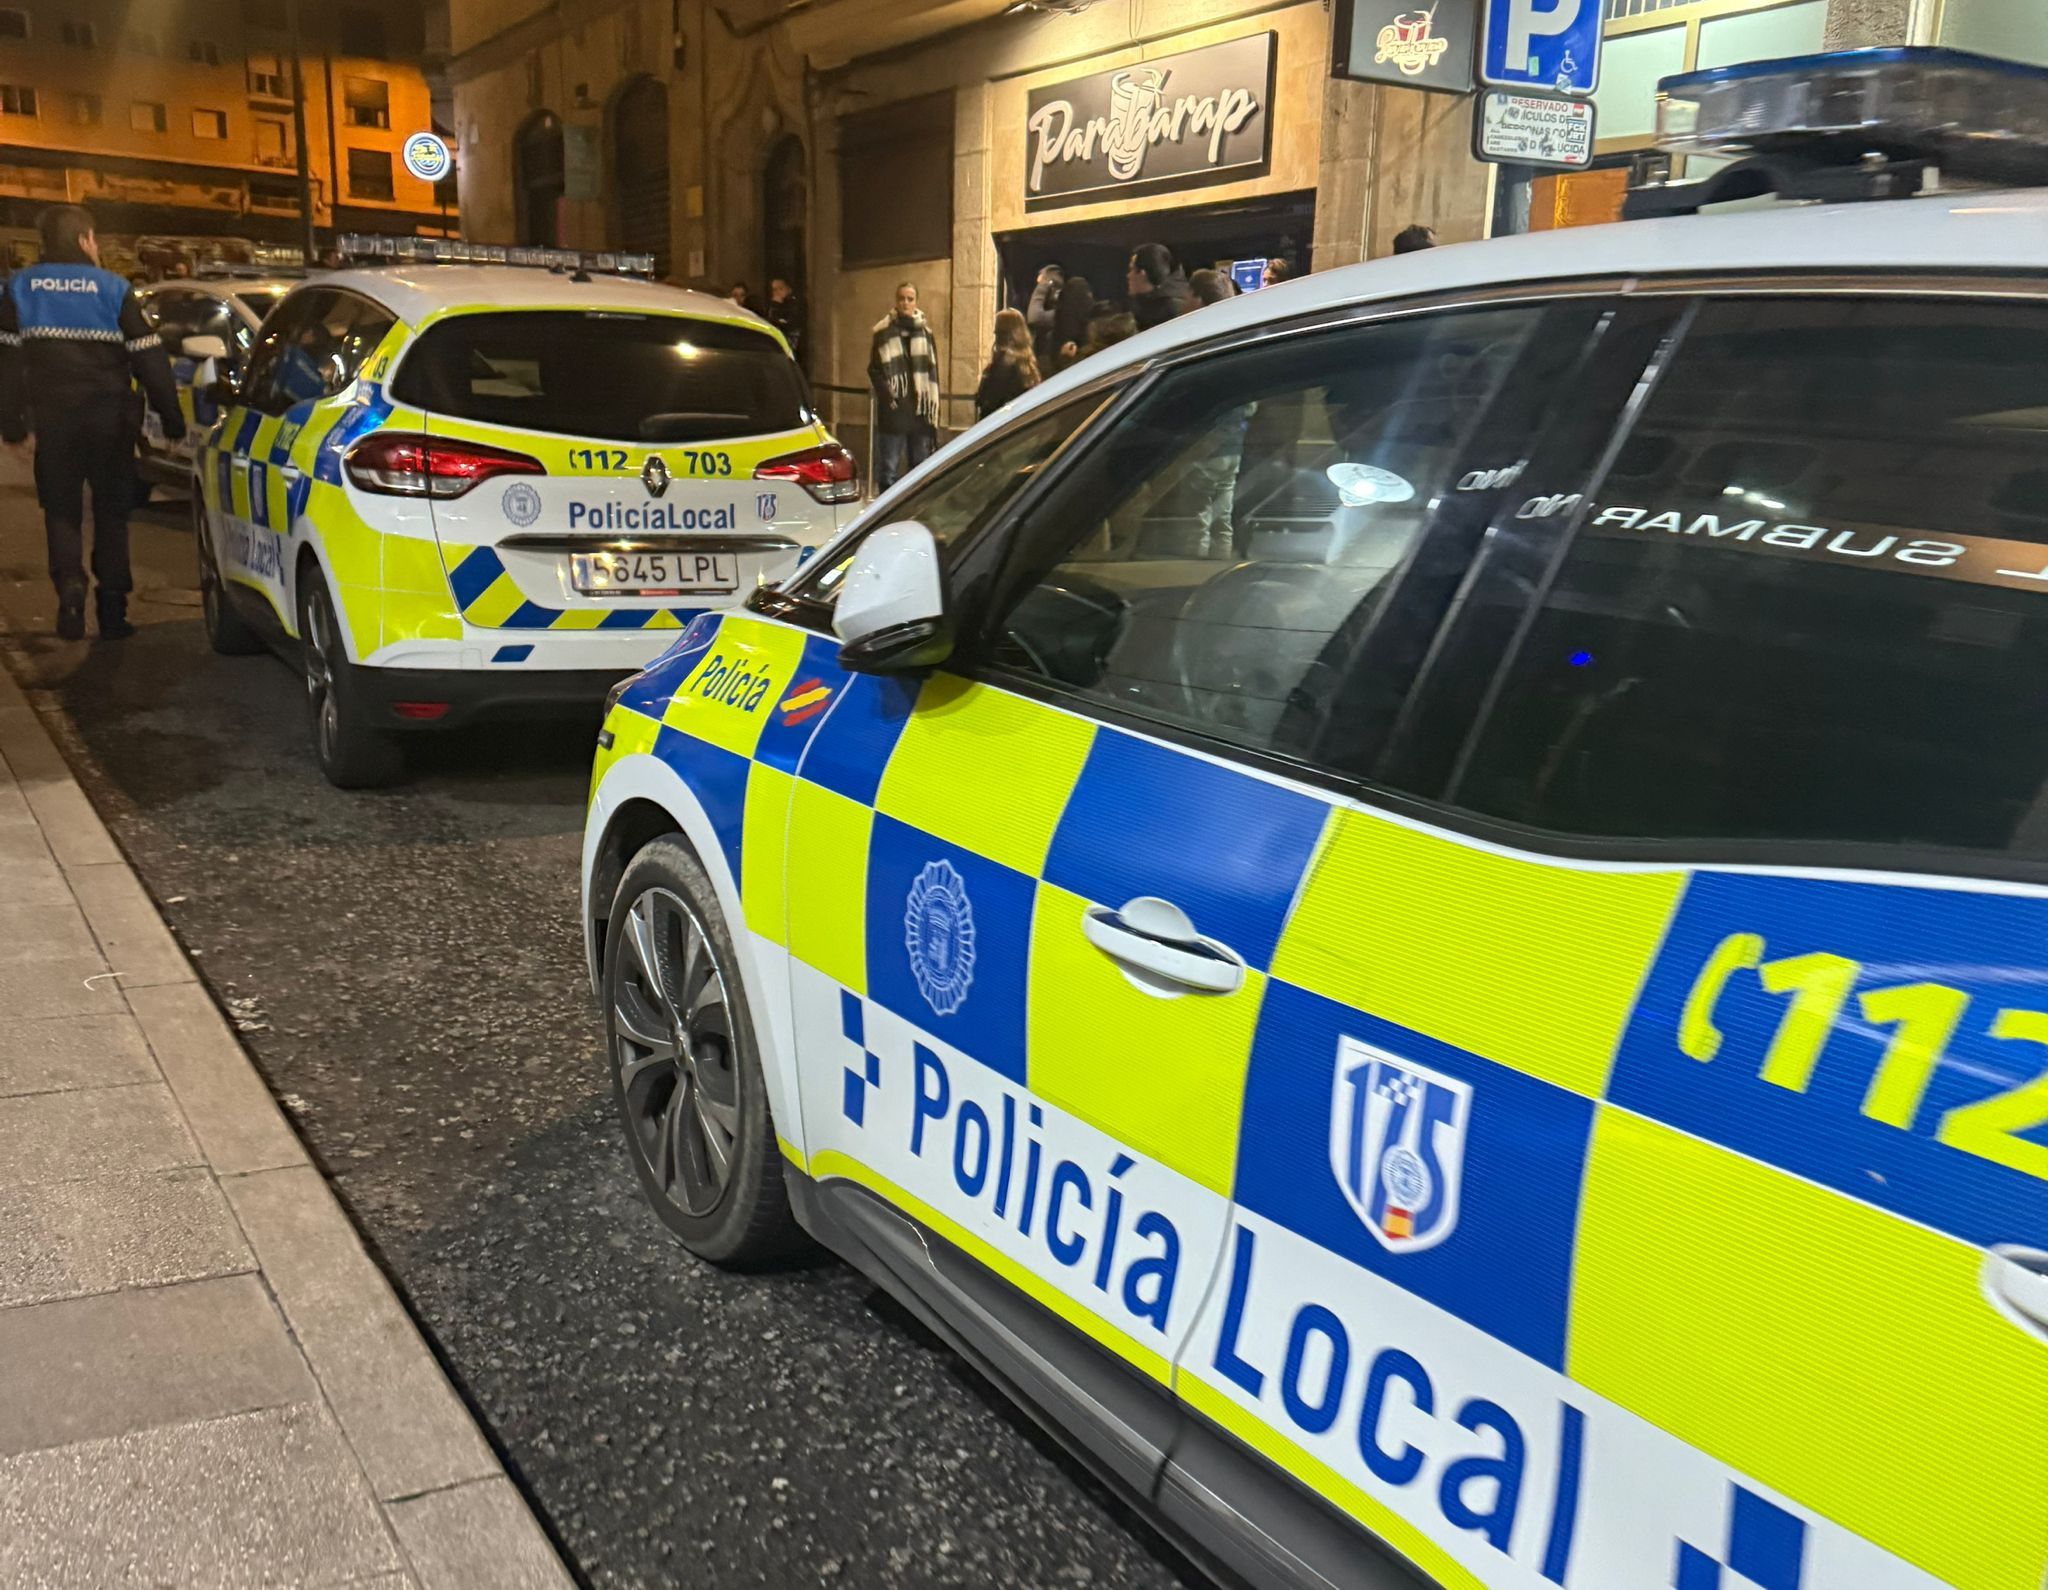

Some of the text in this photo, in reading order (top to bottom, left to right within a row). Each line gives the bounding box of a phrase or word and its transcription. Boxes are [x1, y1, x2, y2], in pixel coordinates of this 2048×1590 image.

[1029, 88, 1259, 191] Parabarap
[577, 449, 629, 470] 112
[684, 451, 732, 475] 703
[678, 556, 729, 583] LPL
[690, 655, 770, 712] Policía
[1759, 952, 2048, 1182] 112
[910, 1040, 1585, 1588] Policía Local
